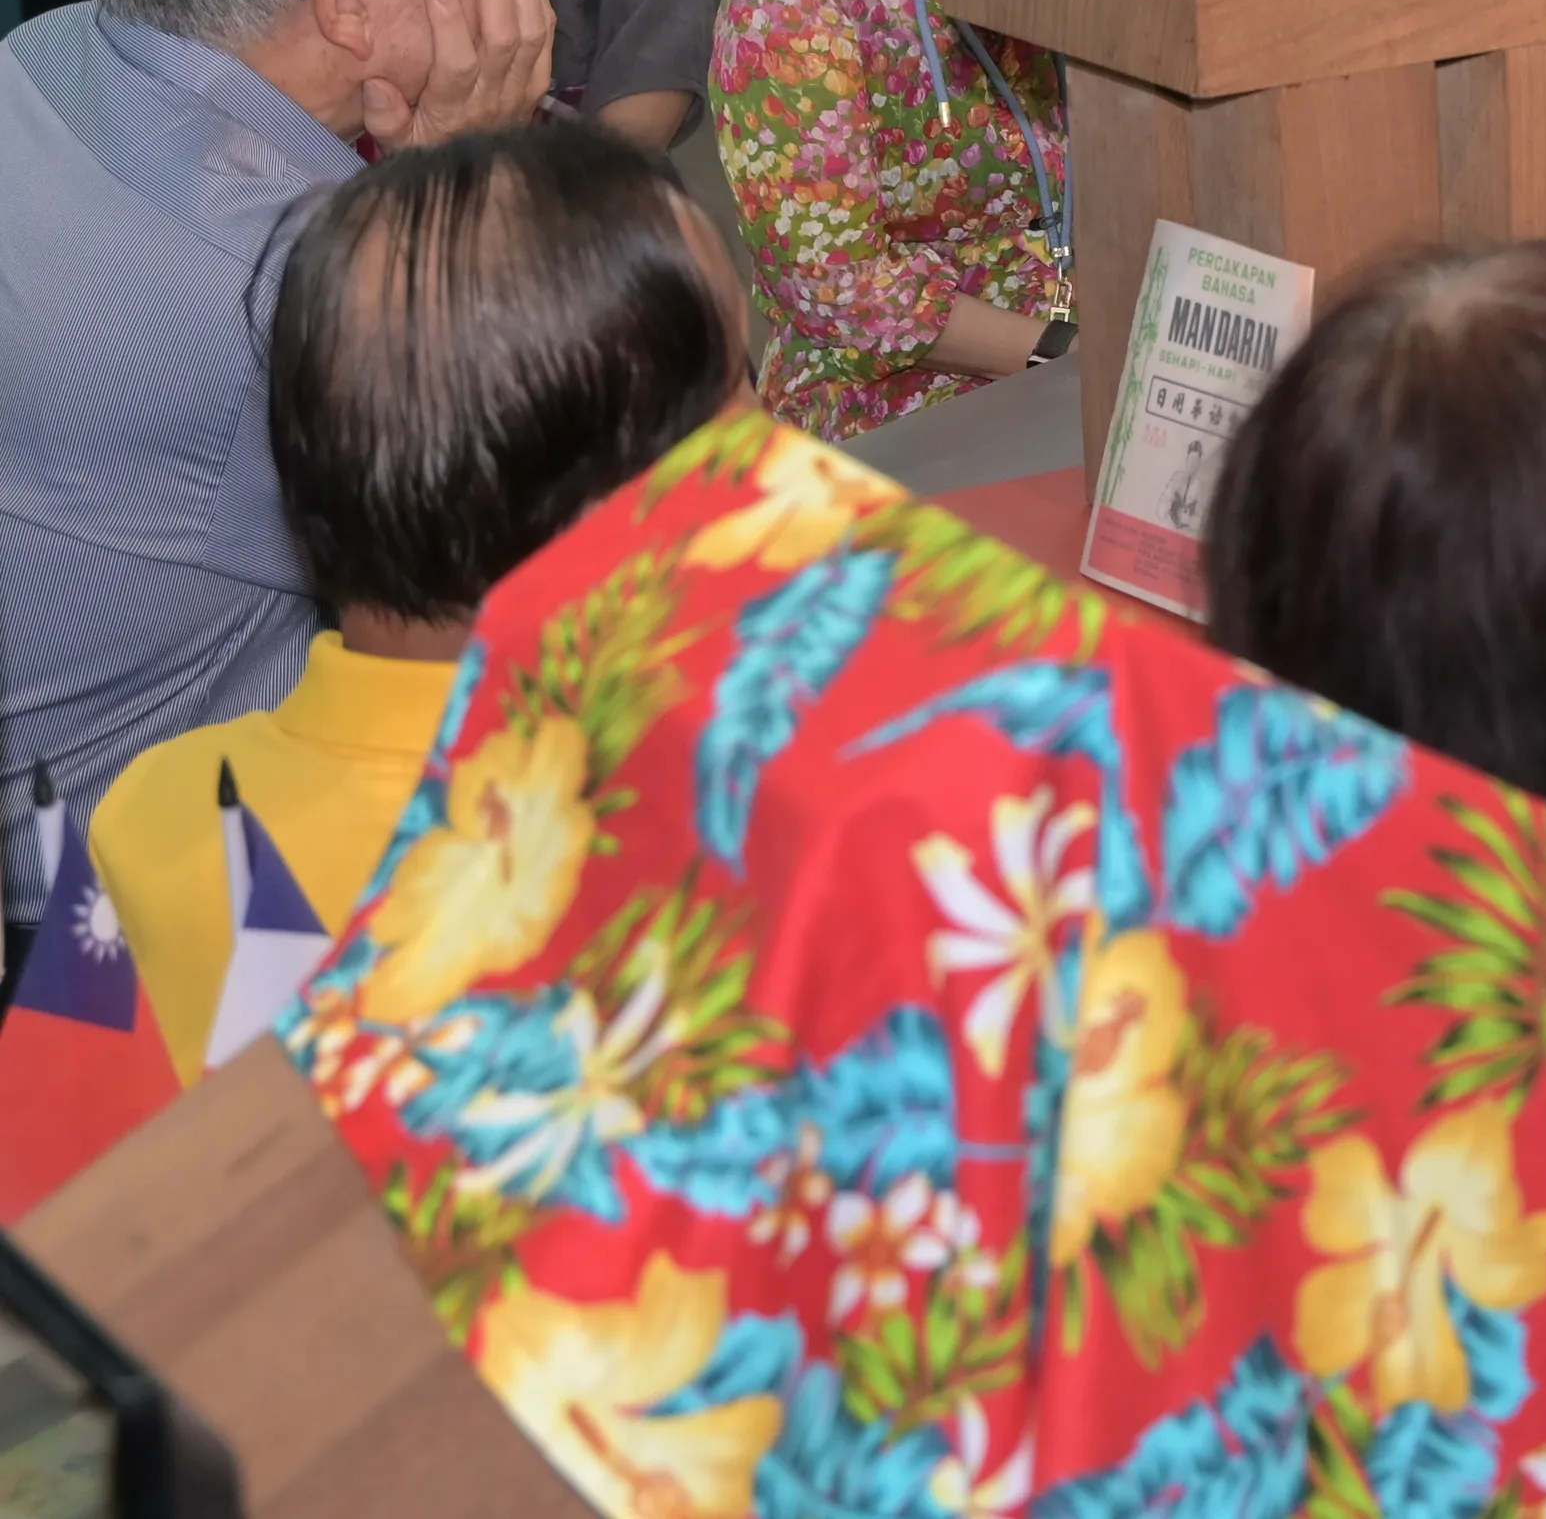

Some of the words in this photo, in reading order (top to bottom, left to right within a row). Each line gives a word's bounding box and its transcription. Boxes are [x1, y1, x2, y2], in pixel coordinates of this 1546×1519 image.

[1187, 246, 1277, 289] PERCAKAPAN
[1201, 276, 1257, 307] BAHASA
[1167, 295, 1279, 373] MANDARIN
